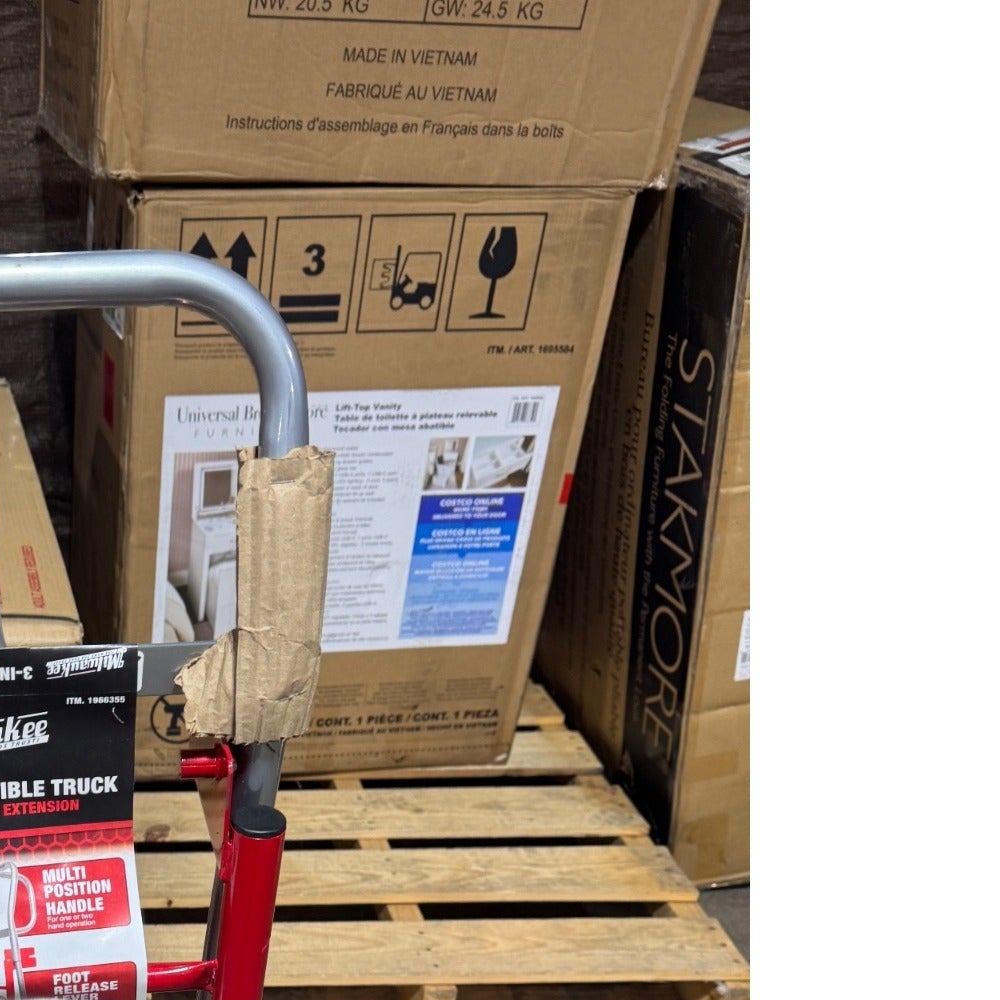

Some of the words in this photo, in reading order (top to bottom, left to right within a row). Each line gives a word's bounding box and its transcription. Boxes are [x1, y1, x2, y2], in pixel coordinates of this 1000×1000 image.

[431, 1, 466, 17] GW:
[471, 1, 508, 19] 24.5
[517, 2, 545, 20] KG
[342, 47, 388, 64] MADE
[391, 49, 407, 64] IN
[410, 49, 478, 66] VIETNAM
[325, 82, 402, 100] FABRIQUÉ
[405, 86, 428, 100] AU
[431, 86, 498, 103] VIETNAM
[226, 115, 303, 131] Instructions
[307, 117, 398, 135] d'assemblage
[401, 123, 418, 134] en
[422, 120, 479, 138] Français
[481, 122, 514, 137] dans
[517, 122, 529, 137] la
[302, 243, 326, 277] 3
[663, 331, 678, 370] The
[177, 404, 239, 423] Universal
[373, 402, 402, 412] Vanity
[654, 373, 673, 441] Folding
[362, 413, 374, 422] de
[641, 337, 716, 761] STAKMORE
[46, 648, 125, 679] Milwaukee
[66, 697, 85, 705] ITM.
[88, 696, 126, 704] 1966355
[316, 716, 352, 728] CONT.
[356, 717, 363, 726] 1
[413, 711, 449, 722] CONT.
[453, 711, 460, 720] 1
[463, 708, 499, 719] PIEZA
[50, 775, 119, 796] TRUCK
[3, 799, 80, 818] EXTENSION
[42, 865, 87, 883] MULTI
[43, 879, 112, 899] POSITION
[45, 897, 104, 916] HANDLE
[47, 921, 65, 930] hand
[65, 919, 96, 930] operation
[53, 971, 90, 986] FOOT
[53, 980, 119, 995] RELEASE
